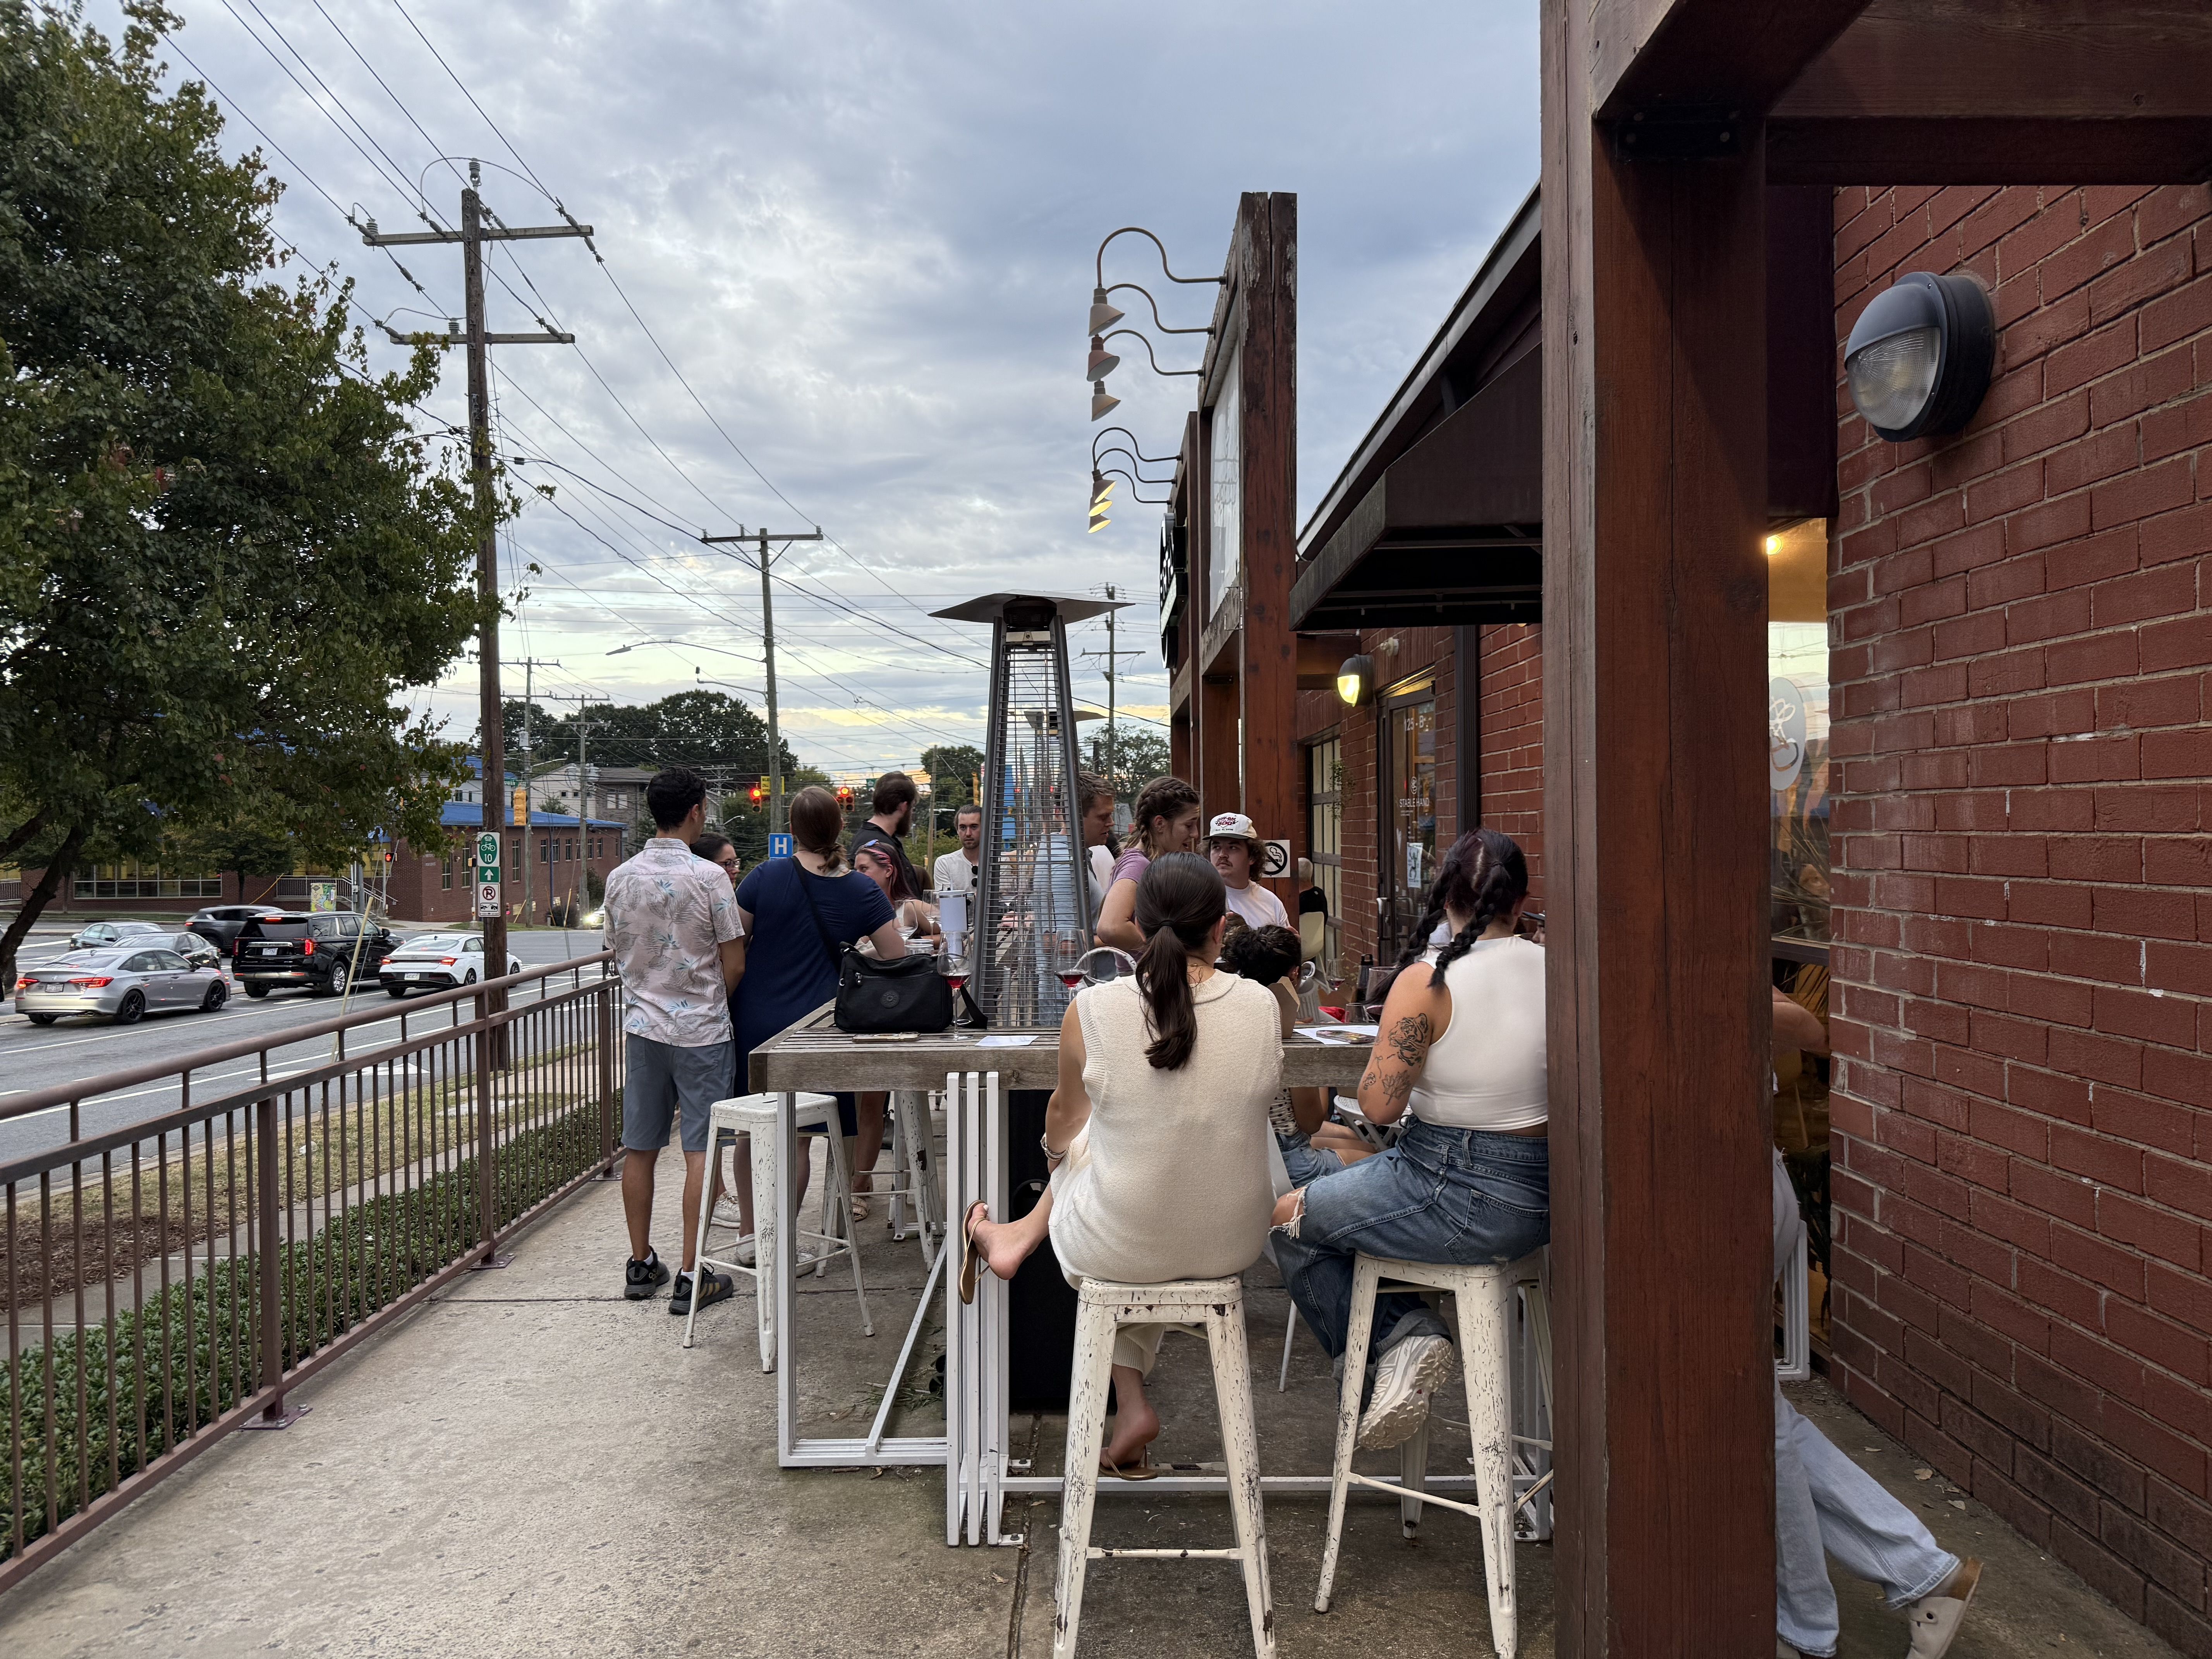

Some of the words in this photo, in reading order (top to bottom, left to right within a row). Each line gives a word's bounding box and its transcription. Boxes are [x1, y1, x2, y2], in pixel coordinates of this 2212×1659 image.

[1400, 798, 1415, 807] STABLE
[1416, 798, 1429, 807] HAND
[775, 837, 787, 854] H
[484, 854, 492, 862] 10
